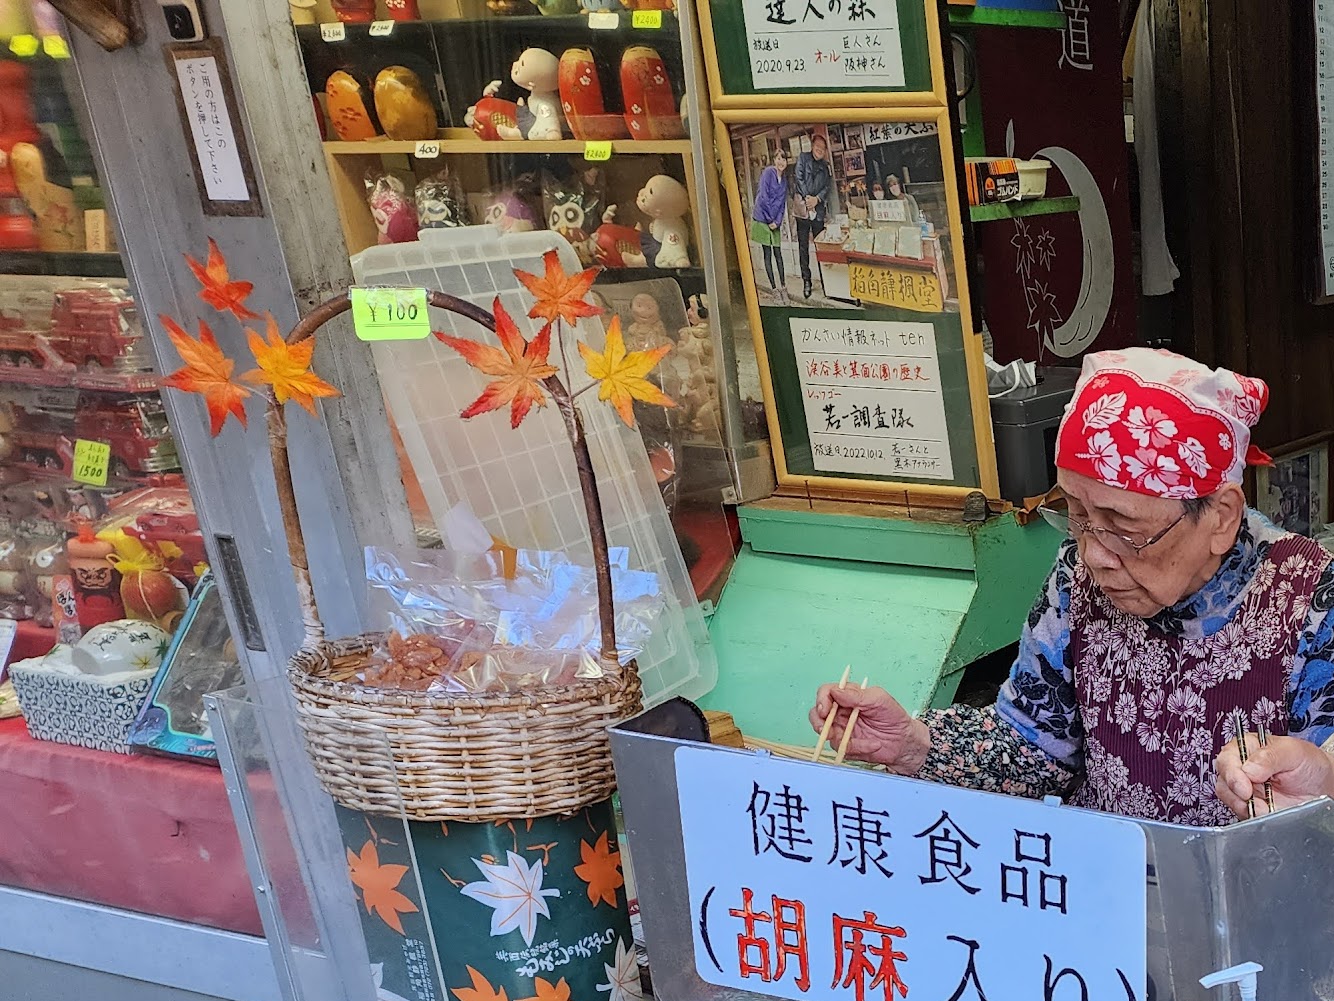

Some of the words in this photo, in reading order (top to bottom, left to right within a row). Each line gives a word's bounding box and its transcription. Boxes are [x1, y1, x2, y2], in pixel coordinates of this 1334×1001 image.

[752, 38, 780, 51] 放送日
[842, 34, 882, 49] 巨人さん
[814, 49, 841, 64] オール
[844, 55, 886, 73] 阪神さん
[418, 144, 438, 154] 400
[852, 266, 938, 308] 稲角静楓堂
[801, 328, 891, 348] かんさい情報ネット
[899, 332, 926, 346] ten
[822, 403, 915, 431] 若一調査隊
[79, 465, 103, 478] 1500
[745, 780, 1068, 915] 健康食品
